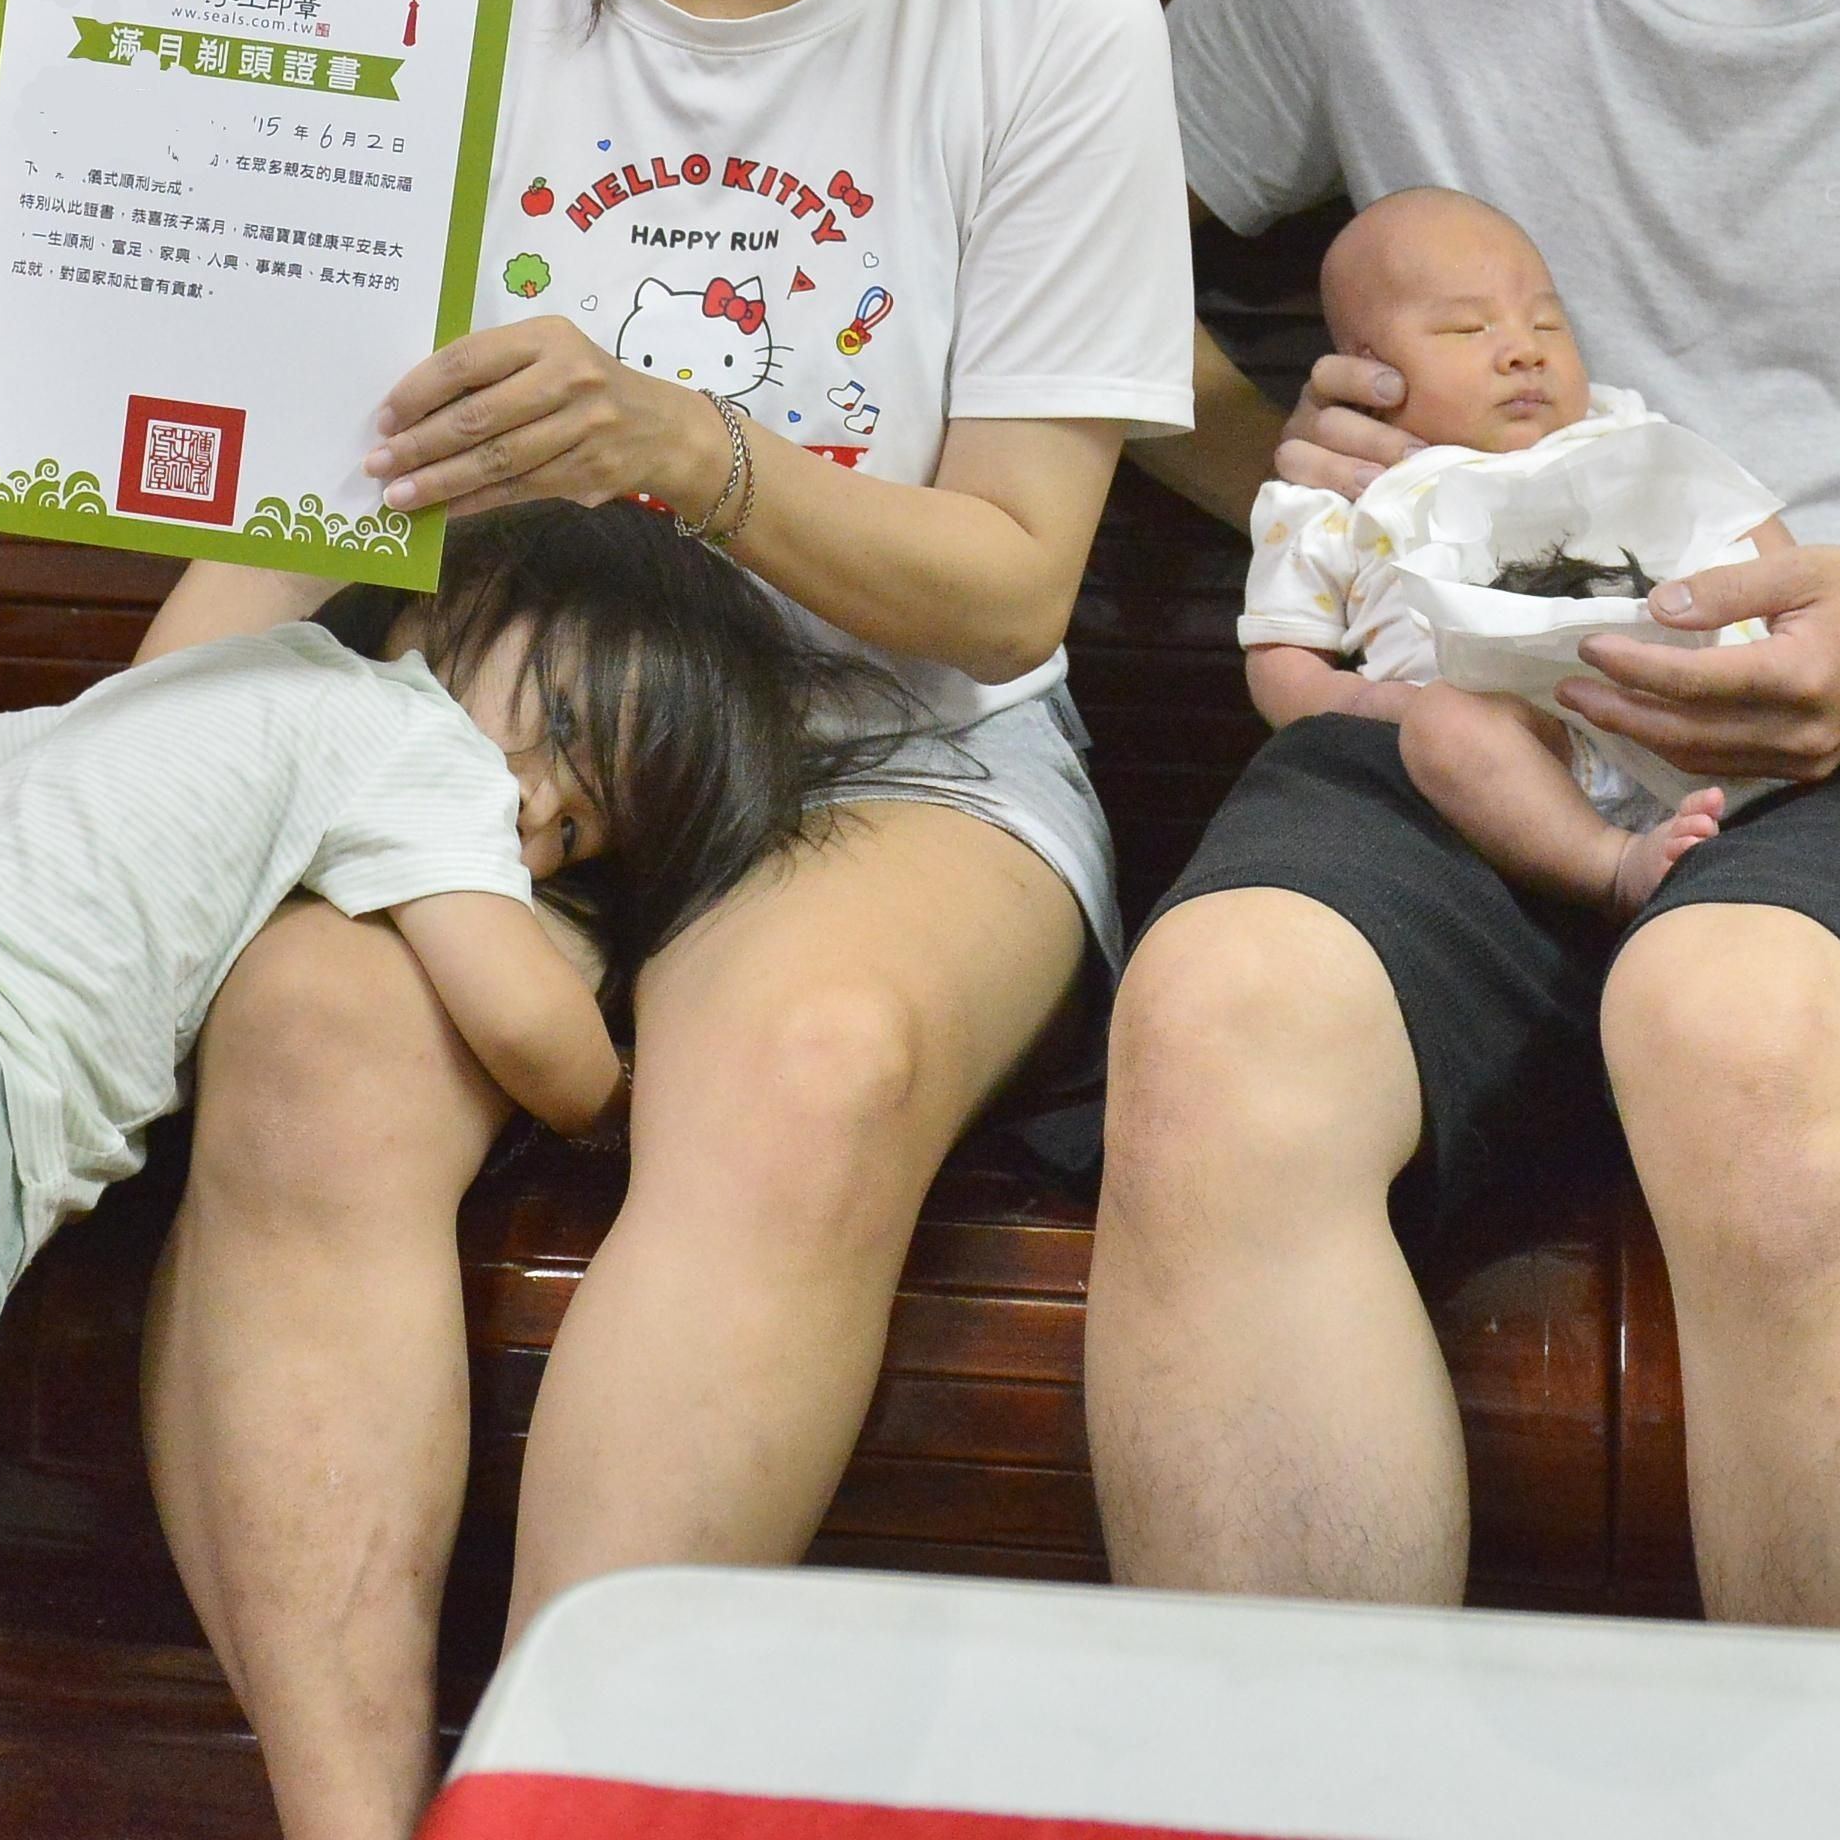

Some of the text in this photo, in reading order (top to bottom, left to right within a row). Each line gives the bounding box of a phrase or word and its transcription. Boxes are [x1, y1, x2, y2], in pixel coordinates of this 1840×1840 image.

[108, 25, 362, 91] 滿月剃頭證書
[565, 154, 847, 245] HELLO KITTY
[630, 225, 779, 251] HAPPY RUN
